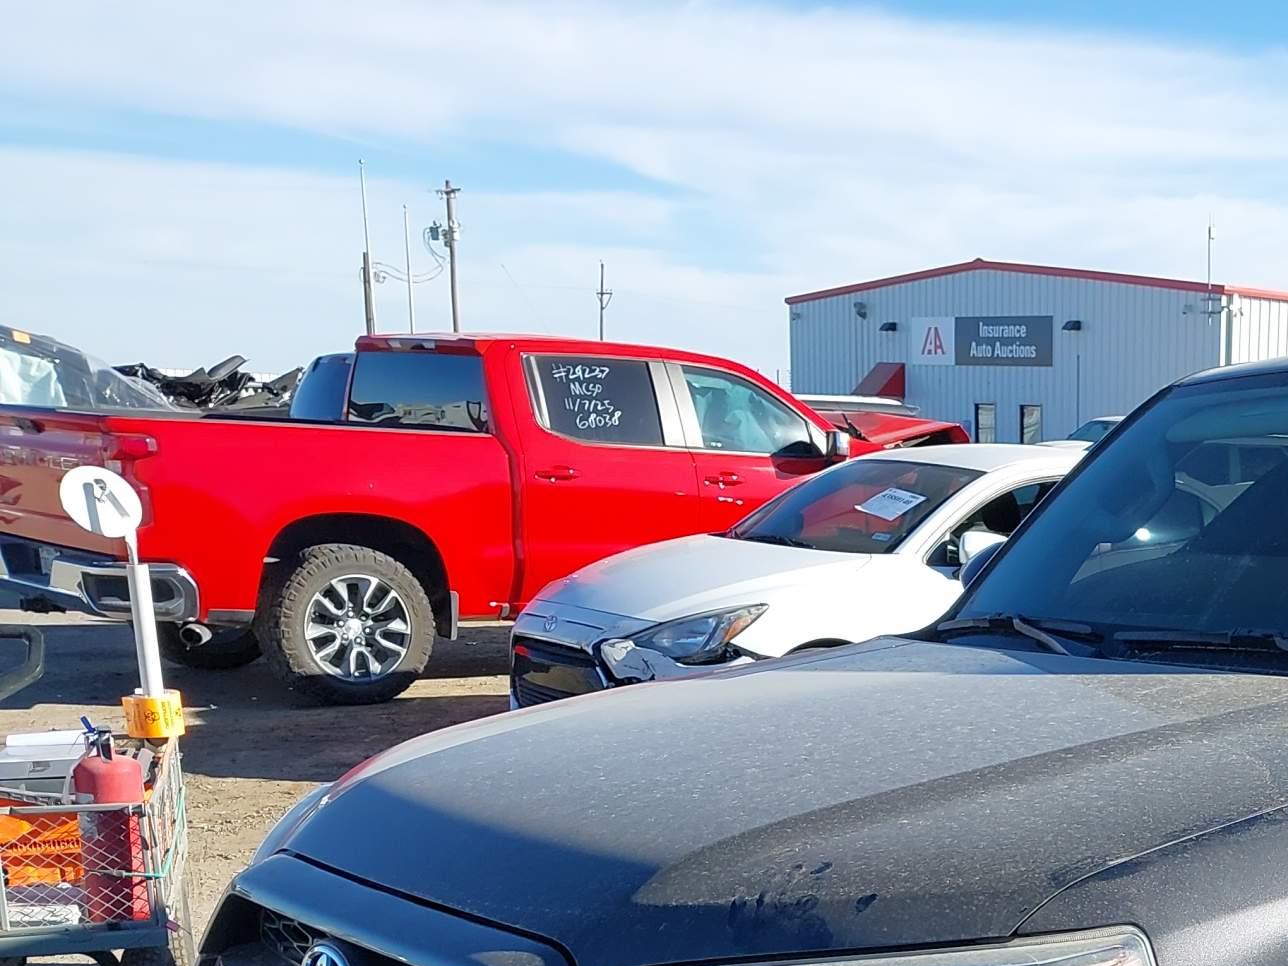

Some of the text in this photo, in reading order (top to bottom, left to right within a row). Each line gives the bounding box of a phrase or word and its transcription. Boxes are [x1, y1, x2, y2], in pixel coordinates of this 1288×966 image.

[979, 321, 1027, 338] Insurance
[970, 341, 1037, 359] Auto Auctions
[564, 397, 614, 413] 11/7/25
[576, 410, 622, 429] 68038
